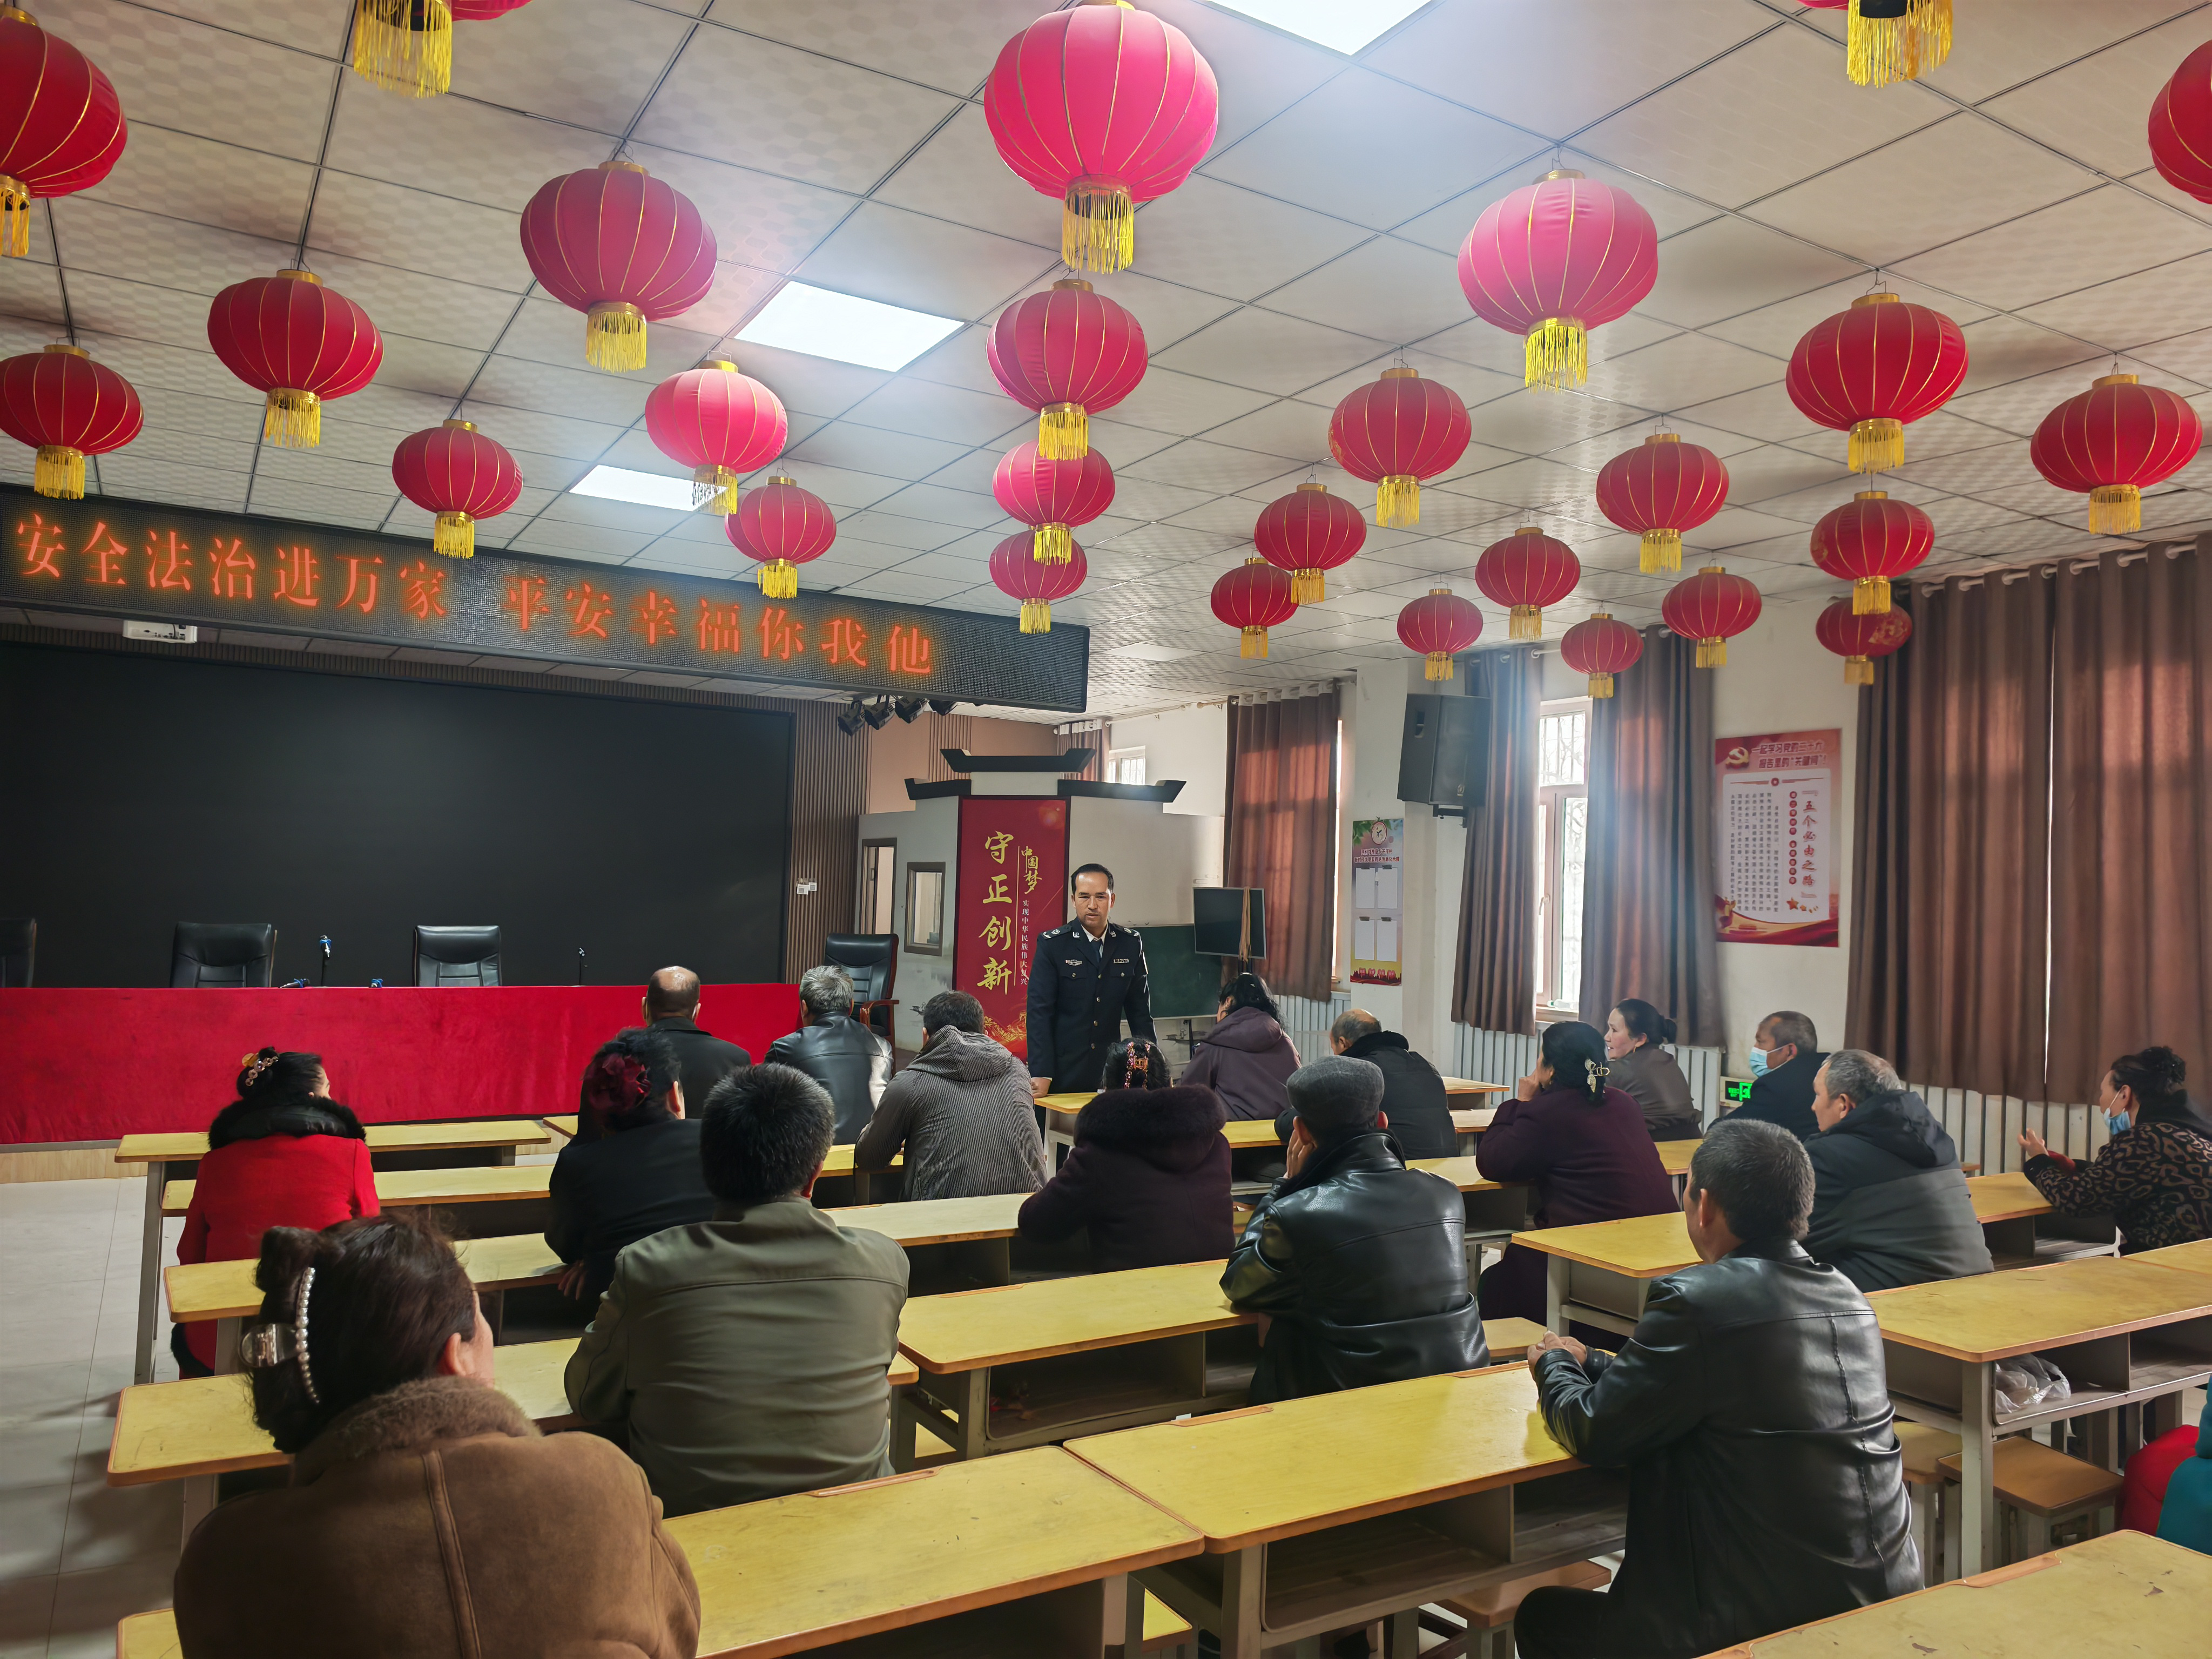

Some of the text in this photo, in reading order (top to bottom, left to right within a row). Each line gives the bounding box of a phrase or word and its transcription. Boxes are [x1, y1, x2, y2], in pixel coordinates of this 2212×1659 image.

[17, 514, 931, 675] 安全法治进万家 平安幸福你我他
[976, 830, 1014, 995] 守正创新
[1021, 845, 1042, 894] 中国梦
[1021, 899, 1030, 985] 实现中华民族伟大复兴
